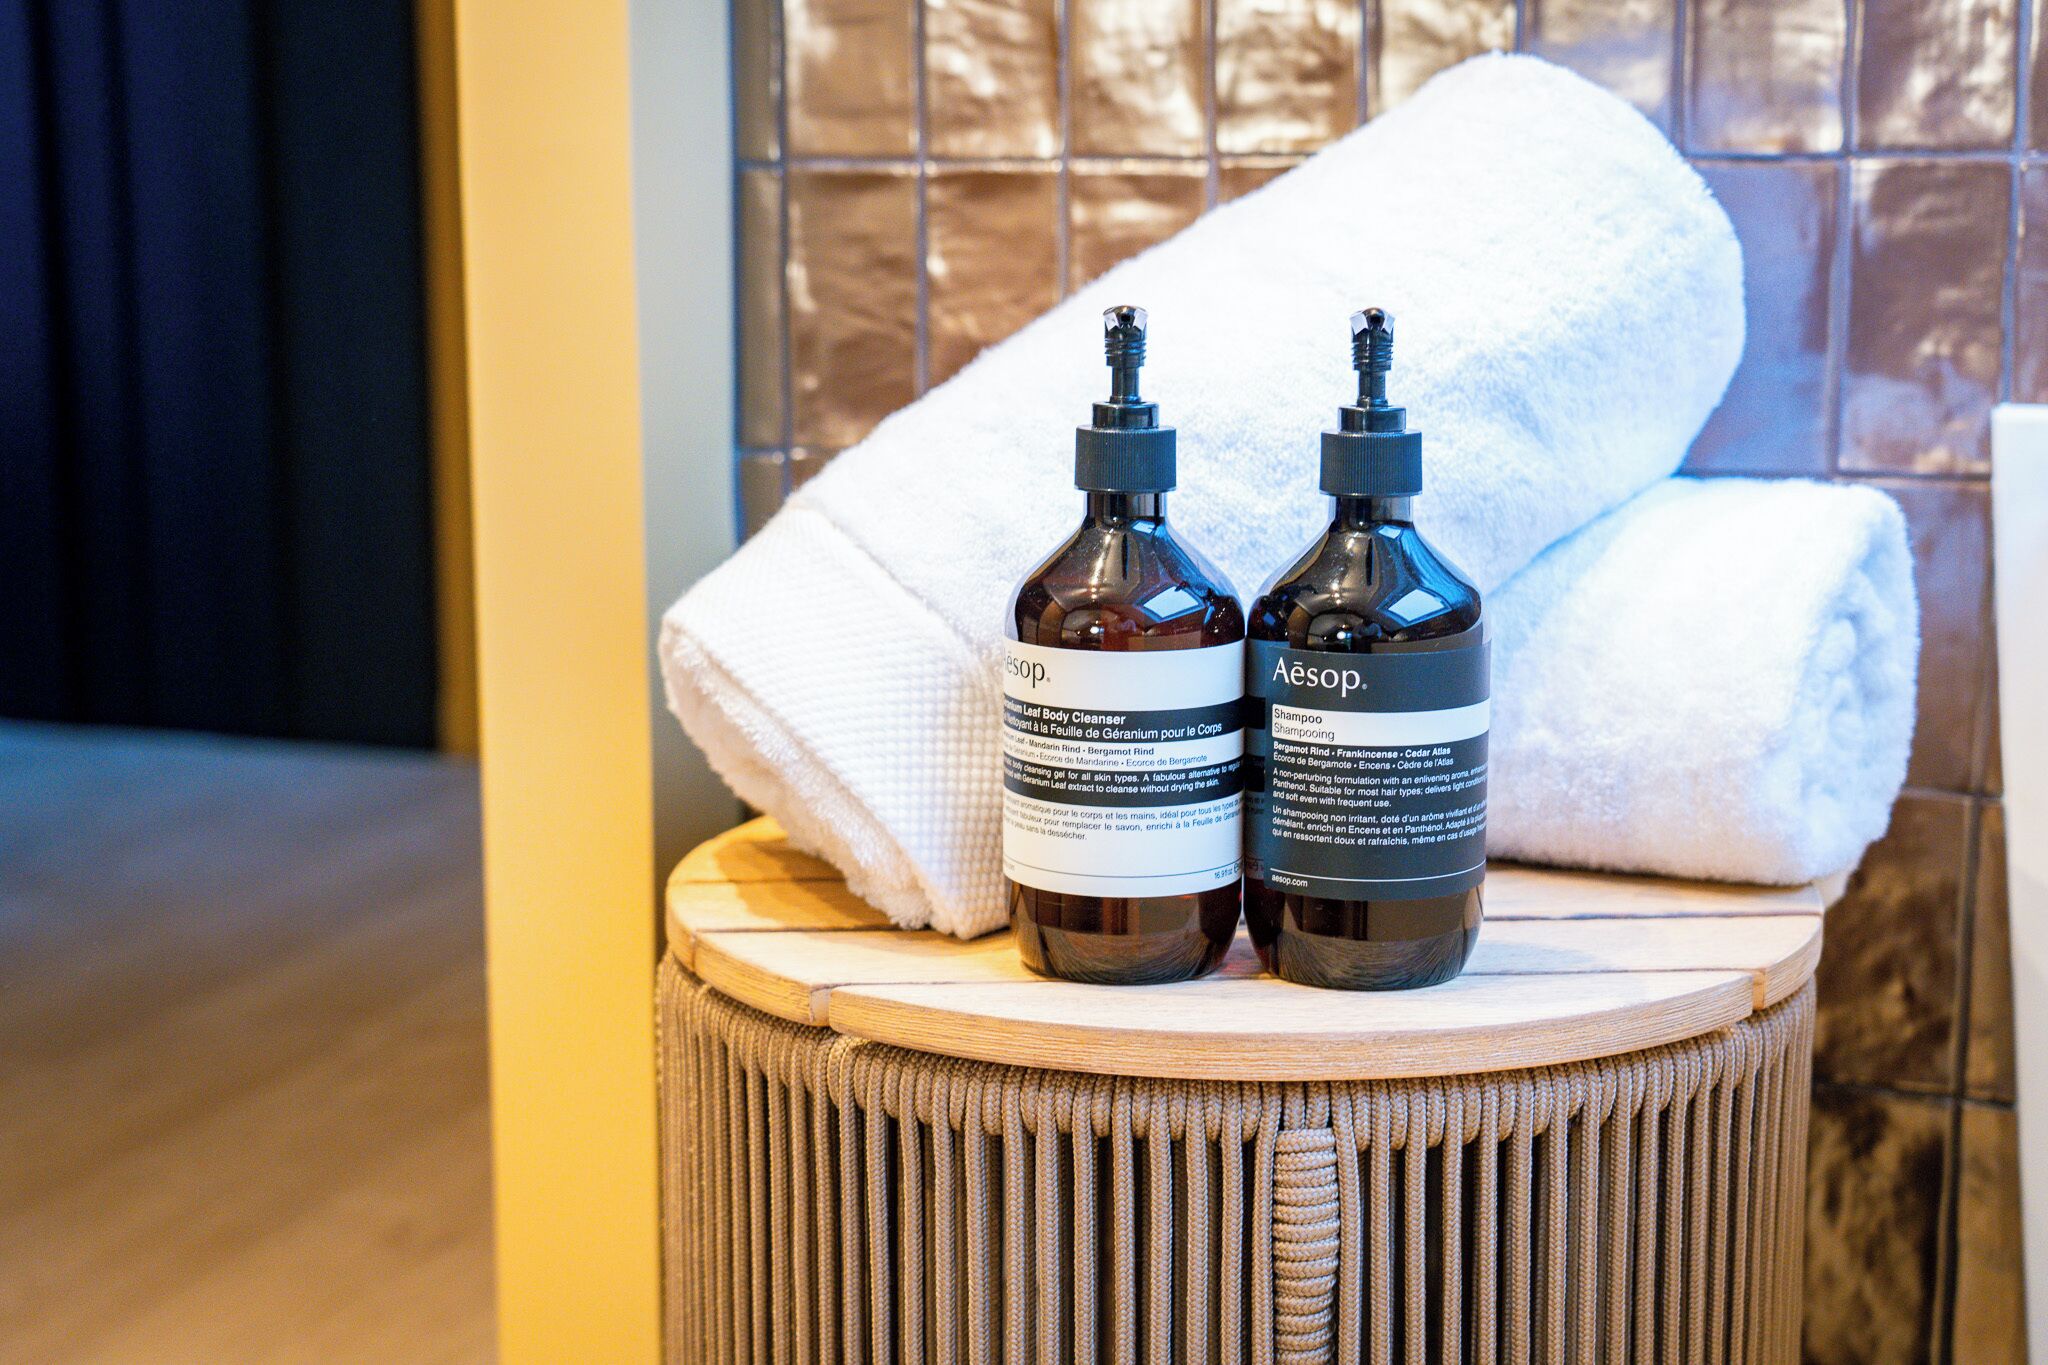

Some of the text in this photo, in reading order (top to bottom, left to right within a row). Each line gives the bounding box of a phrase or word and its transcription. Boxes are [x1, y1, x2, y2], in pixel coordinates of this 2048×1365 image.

[1023, 705, 1041, 718] Leaf
[1043, 708, 1069, 724] Body
[1072, 711, 1126, 725] Cleanser
[1274, 708, 1322, 724] Shampoo
[1033, 721, 1039, 732] à
[1041, 722, 1048, 733] la
[1050, 724, 1083, 738] Feuille
[1085, 727, 1100, 738] de
[1102, 727, 1158, 740] Géranium
[1160, 729, 1185, 741] pour
[1187, 725, 1195, 737] le
[1197, 723, 1222, 735] Corps
[1273, 722, 1335, 742] Shampooing
[1029, 740, 1060, 751] Mandarin
[1062, 744, 1081, 754] Rind
[1087, 746, 1131, 757] Bergamot
[1133, 747, 1154, 756] Rind
[1273, 741, 1451, 759] Bergamot Rind Frankincense Cedar Atlas
[1076, 757, 1119, 767] Mandarine
[1156, 758, 1167, 766] de
[1169, 754, 1208, 766] Bergamote
[1273, 751, 1454, 770] Écorce de Bergamote Encens Cèdre de l'Atlas
[1023, 764, 1051, 779] cleansing
[1053, 770, 1065, 779] gel
[1068, 771, 1078, 780] for
[1081, 772, 1091, 781] all
[1094, 773, 1111, 782] skin
[1114, 774, 1140, 784] types.
[1142, 773, 1150, 782] A
[1152, 771, 1186, 781] fabulous
[1273, 767, 1279, 775] A
[1279, 769, 1332, 785] non-perturbing
[1333, 774, 1381, 785] formulation
[1382, 775, 1400, 785] with
[1401, 777, 1412, 785] an
[1414, 774, 1450, 783] enlivening
[1051, 779, 1066, 789] Leaf
[1067, 783, 1095, 792] extract
[1096, 784, 1104, 793] to
[1105, 784, 1139, 793] cleanse
[1140, 783, 1170, 793] without
[1170, 782, 1194, 793] drying
[1194, 780, 1206, 789] the
[1273, 778, 1308, 791] Panthenol.
[1309, 783, 1342, 795] Suitable
[1344, 786, 1356, 796] for
[1357, 788, 1379, 796] most
[1381, 787, 1397, 796] hair
[1424, 784, 1452, 795] delivers
[1452, 780, 1465, 792] light
[1272, 790, 1392, 808] and soft even with frequent use.
[1080, 811, 1103, 820] corps
[1105, 812, 1114, 820] et
[1115, 812, 1129, 820] les
[1130, 811, 1158, 820] mains,
[1180, 809, 1197, 819] pour
[1272, 805, 1282, 814] Un
[1282, 807, 1329, 823] shampooing
[1330, 814, 1347, 823] non
[1348, 814, 1379, 824] irritant,
[1380, 814, 1401, 824] doté
[1401, 814, 1420, 823] d'un
[1421, 812, 1445, 822] arôme
[1062, 820, 1101, 830] remplacer
[1104, 822, 1112, 831] le
[1146, 821, 1173, 830] enrichi
[1183, 820, 1190, 828] la
[1306, 823, 1334, 833] enrichi
[1335, 826, 1347, 834] en
[1348, 825, 1381, 835] Encens
[1382, 826, 1391, 835] et
[1392, 827, 1403, 835] en
[1404, 822, 1445, 834] Panthénol.
[1445, 818, 1467, 830] Adapté
[1272, 828, 1282, 838] qui
[1283, 830, 1292, 838] en
[1293, 832, 1332, 844] ressortent
[1334, 835, 1356, 845] doux
[1357, 836, 1366, 845] et
[1411, 835, 1436, 844] même
[1436, 834, 1446, 843] en
[1446, 832, 1459, 841] cas
[1272, 873, 1308, 888] aesop.com
